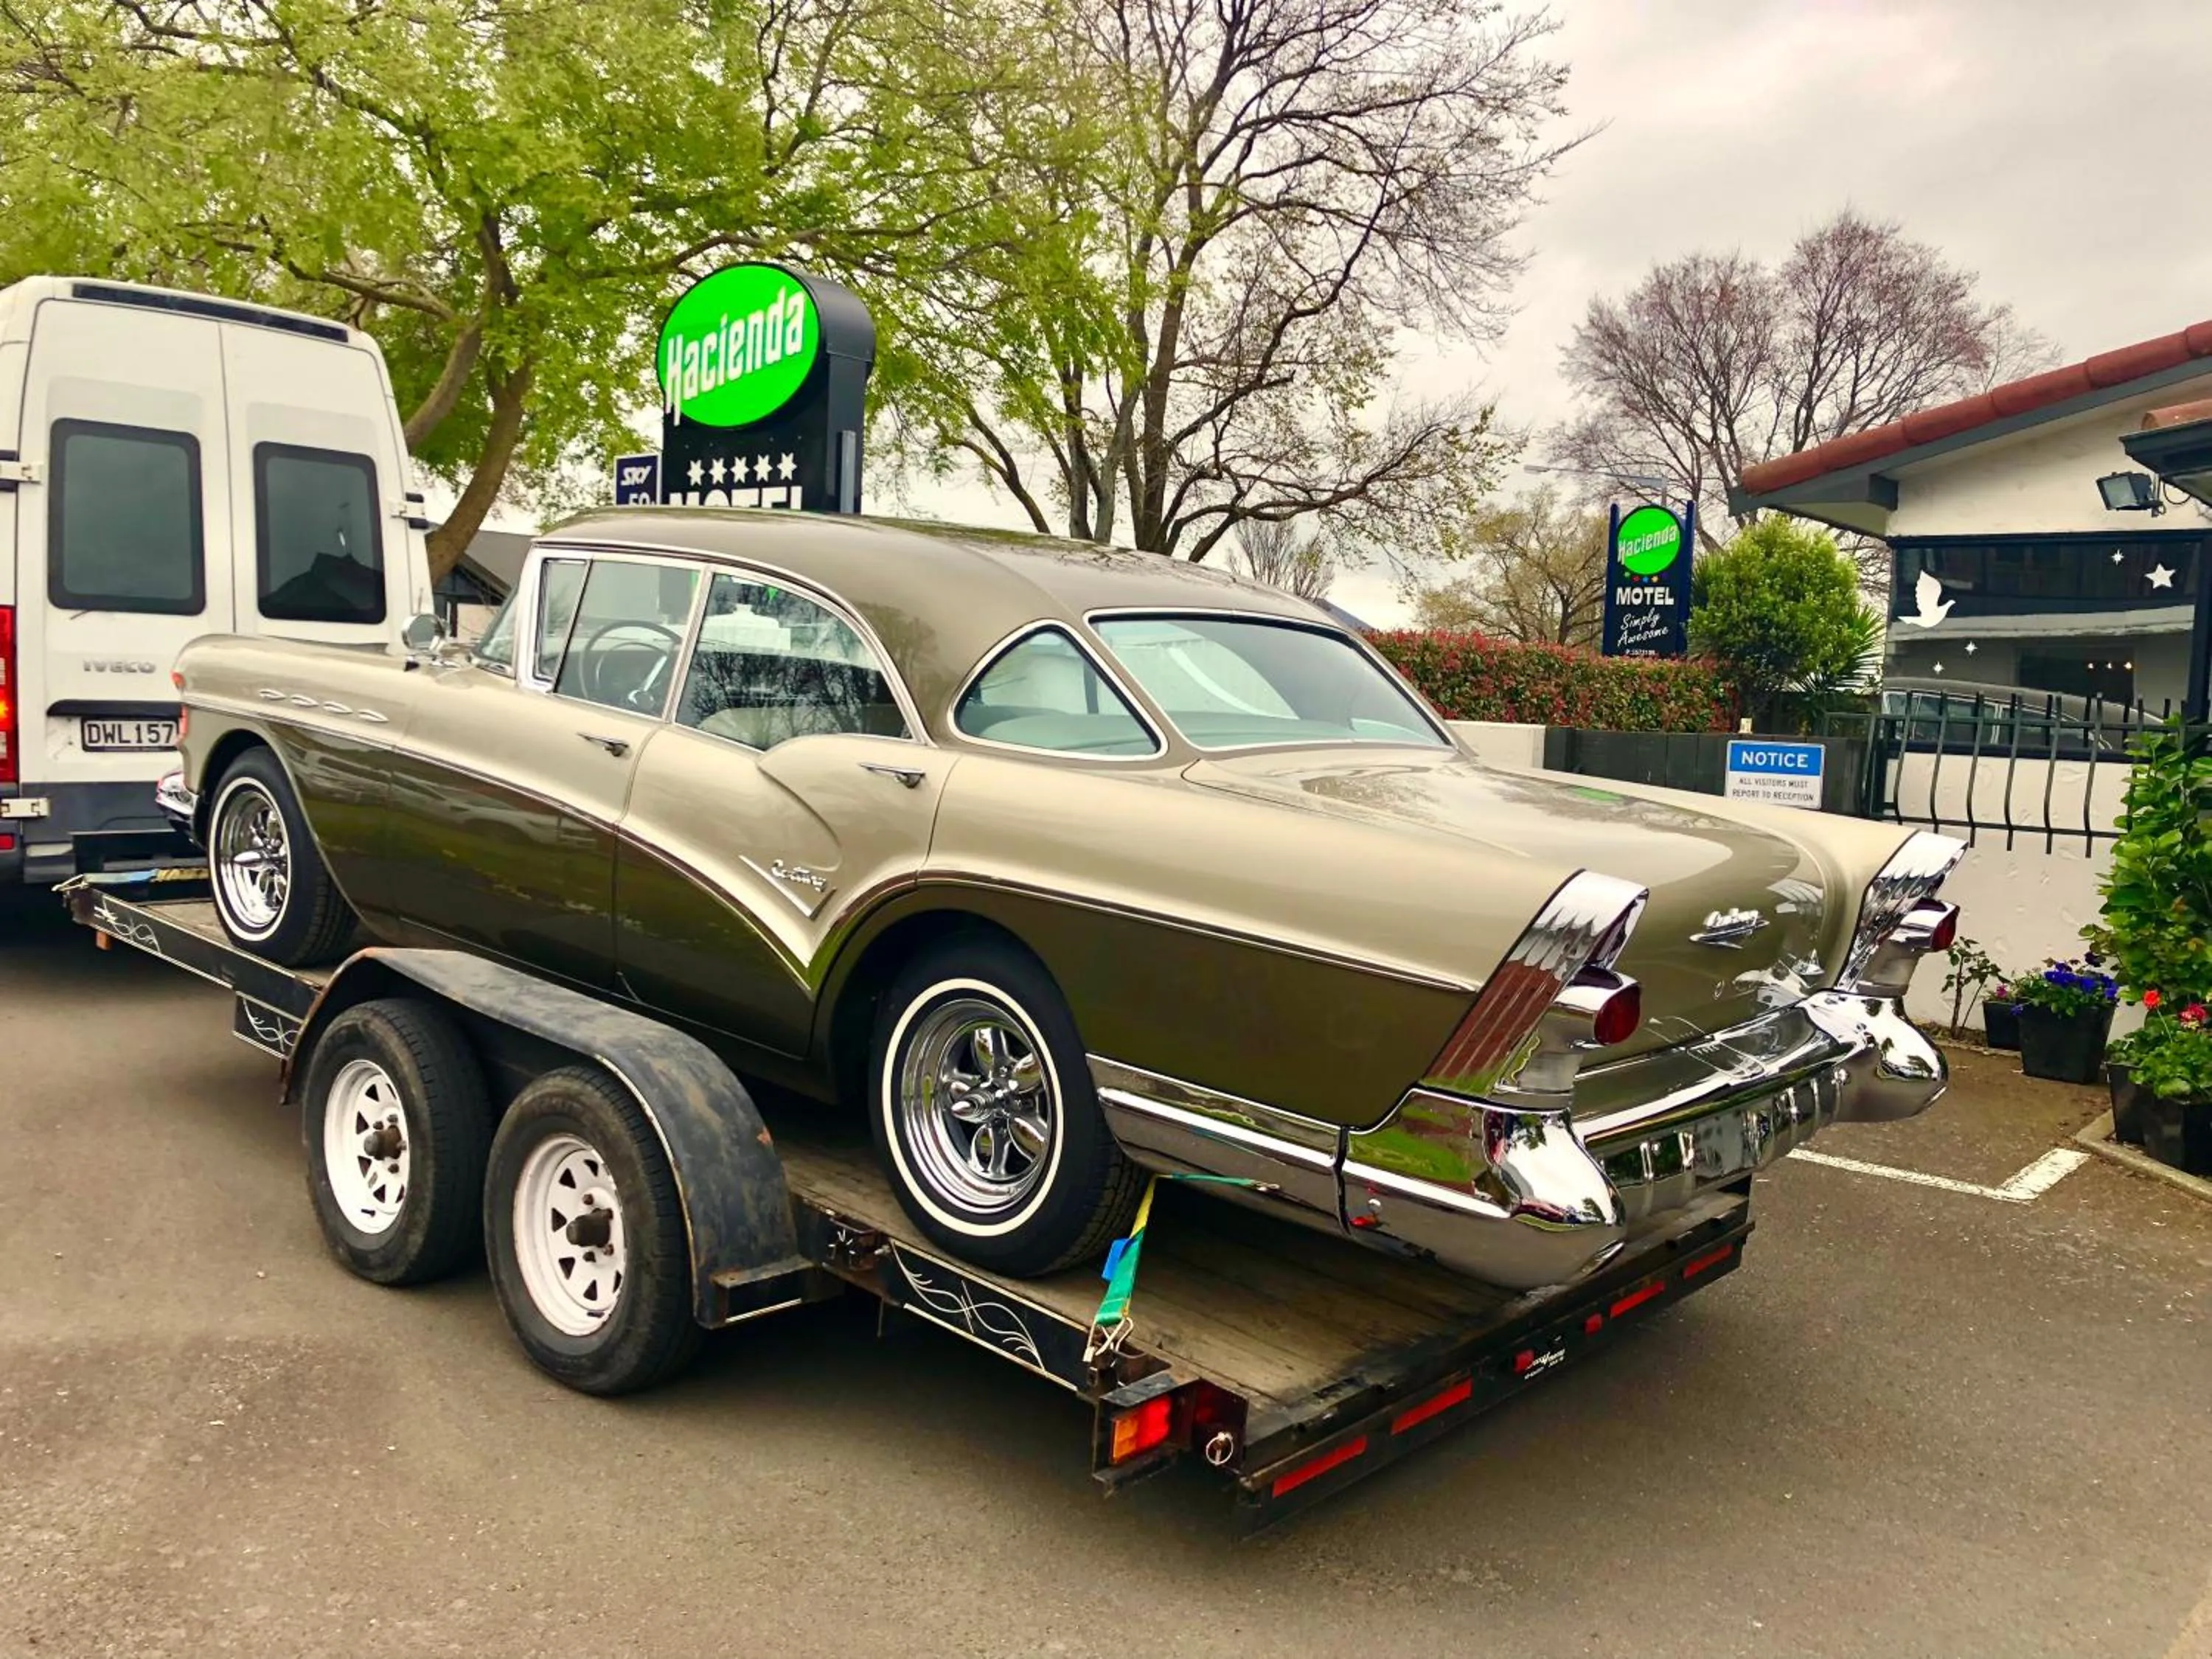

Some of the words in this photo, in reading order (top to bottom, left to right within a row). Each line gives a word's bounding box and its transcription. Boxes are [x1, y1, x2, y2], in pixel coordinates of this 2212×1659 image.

[664, 286, 806, 427] Hacienda
[620, 465, 653, 486] SKY
[1617, 524, 1679, 566] Hacienda
[1615, 587, 1674, 605] MOTEL
[1620, 607, 1661, 631] Simply
[1617, 627, 1669, 647] Awesome
[83, 660, 156, 674] IVECO
[87, 723, 174, 744] DWL157
[1741, 751, 1809, 768] NOTICE
[1755, 779, 1787, 787] VISITORS
[1788, 780, 1808, 788] MUST
[1733, 789, 1759, 799] REPORT
[1762, 790, 1771, 799] TO
[1773, 791, 1815, 801] RECEPTION
